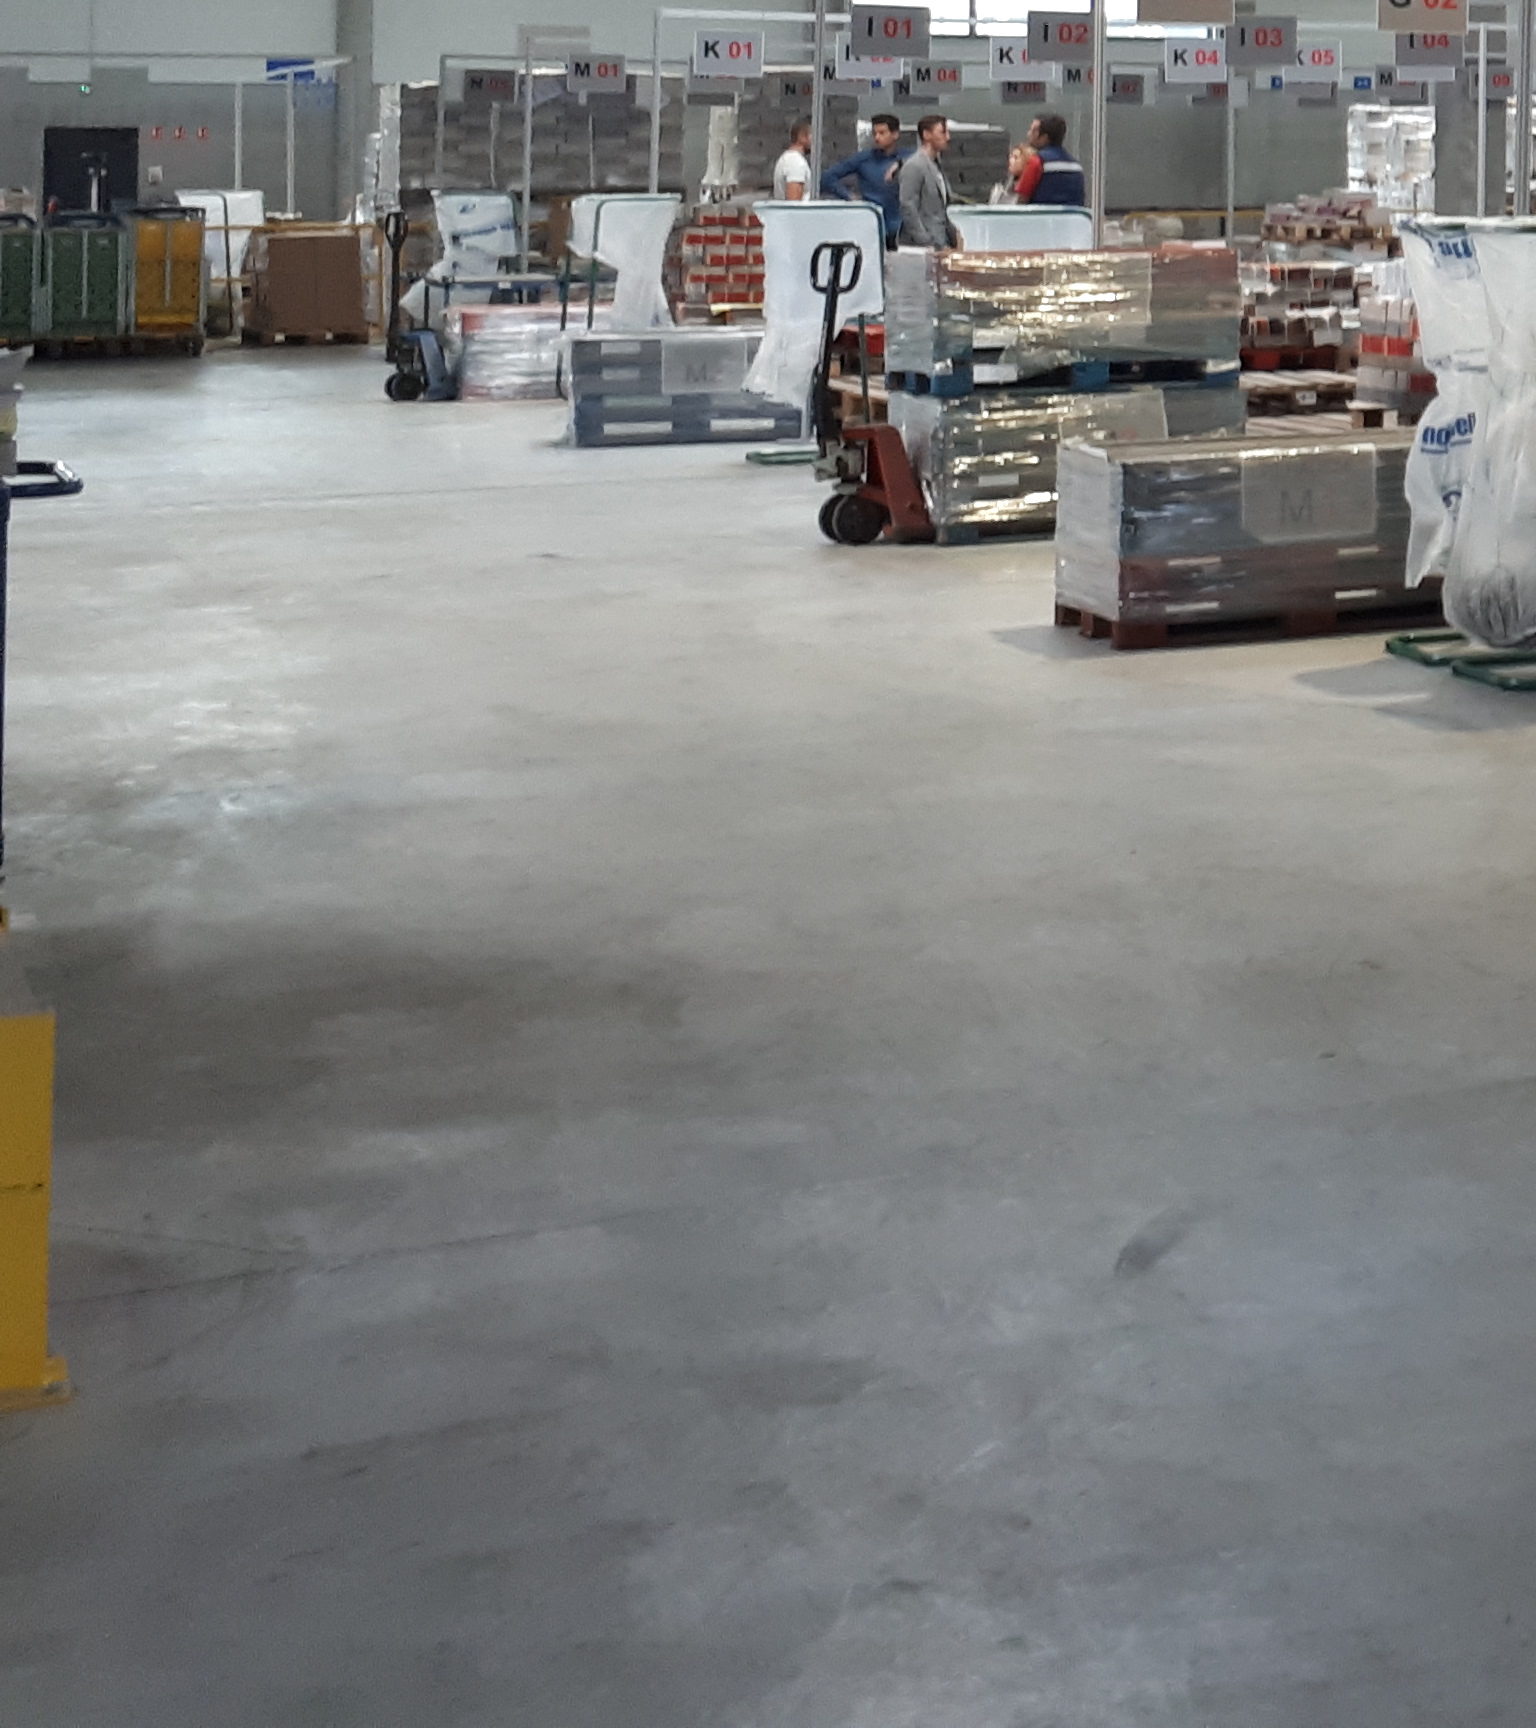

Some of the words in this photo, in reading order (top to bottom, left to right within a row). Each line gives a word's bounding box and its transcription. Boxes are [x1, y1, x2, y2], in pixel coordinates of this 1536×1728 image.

[867, 16, 874, 37] I
[882, 18, 913, 39] 01
[1043, 23, 1049, 42] I
[1058, 24, 1089, 43] 02
[1239, 27, 1246, 46] I
[1254, 27, 1283, 47] 03
[703, 40, 720, 59] K
[728, 41, 752, 59] 01
[1173, 49, 1188, 66] K
[1195, 49, 1219, 65] 04
[1311, 49, 1334, 65] 05
[574, 62, 591, 77] M
[597, 63, 620, 78] 01
[916, 66, 931, 81] M
[936, 68, 957, 82] 04
[1067, 69, 1081, 83] M
[1380, 72, 1393, 86] M
